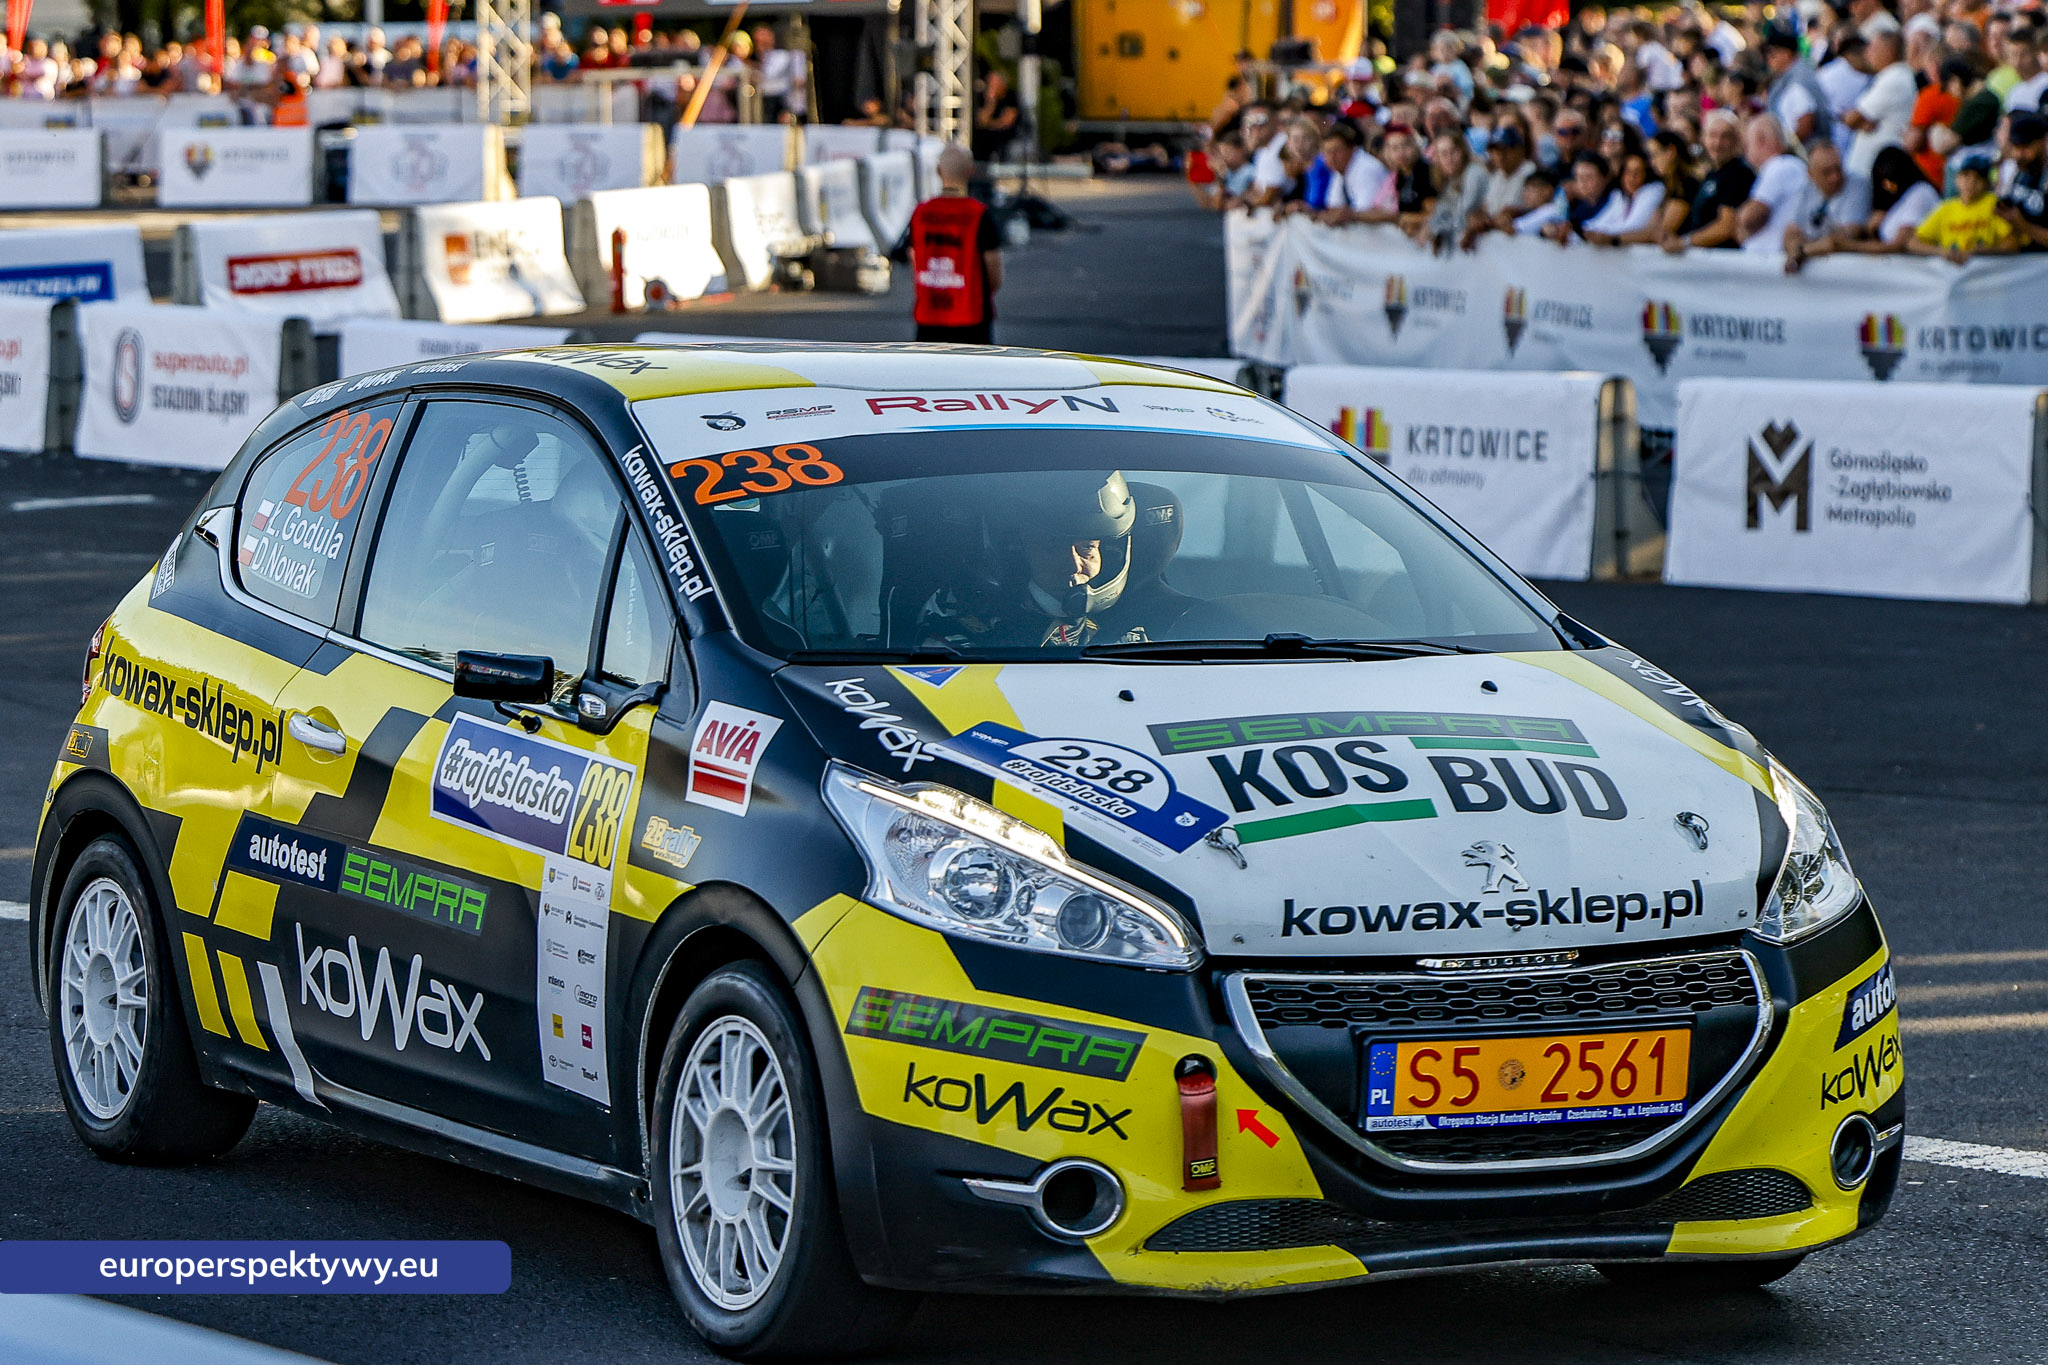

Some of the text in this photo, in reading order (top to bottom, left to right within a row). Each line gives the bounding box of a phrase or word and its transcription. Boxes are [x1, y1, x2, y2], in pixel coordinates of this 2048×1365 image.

[1690, 313, 1787, 345] KATOWICE
[284, 410, 393, 520] 238
[1408, 425, 1548, 461] KATOWICE
[670, 443, 844, 505] 238
[622, 444, 713, 603] kowax-sklep.pl
[251, 536, 317, 594] D.Nowak
[100, 635, 286, 774] kowax-sklep.pl
[1166, 715, 1572, 751] SEMPRA
[1006, 761, 1133, 816] #rajdslaska
[1041, 744, 1155, 794] 238
[1206, 740, 1629, 821] KOS BUD
[443, 746, 630, 868] #rajdslaska 238
[249, 833, 327, 881] autotest
[341, 852, 487, 930] SEMPRA
[1281, 878, 1703, 937] kowax-sklep.pl
[1458, 955, 1559, 968] PEUGEOT
[850, 994, 1139, 1073] SEMPRA
[1371, 1090, 1391, 1105] PL
[1408, 1036, 1666, 1108] S5 2561
[1372, 1117, 1425, 1128] autotest.pl
[1476, 1115, 1499, 1126] Stacja
[1500, 1113, 1529, 1124] Kontroli
[1567, 1108, 1608, 1120] Czechowice
[1670, 1103, 1683, 1113] 243
[1191, 1161, 1216, 1175] OMP
